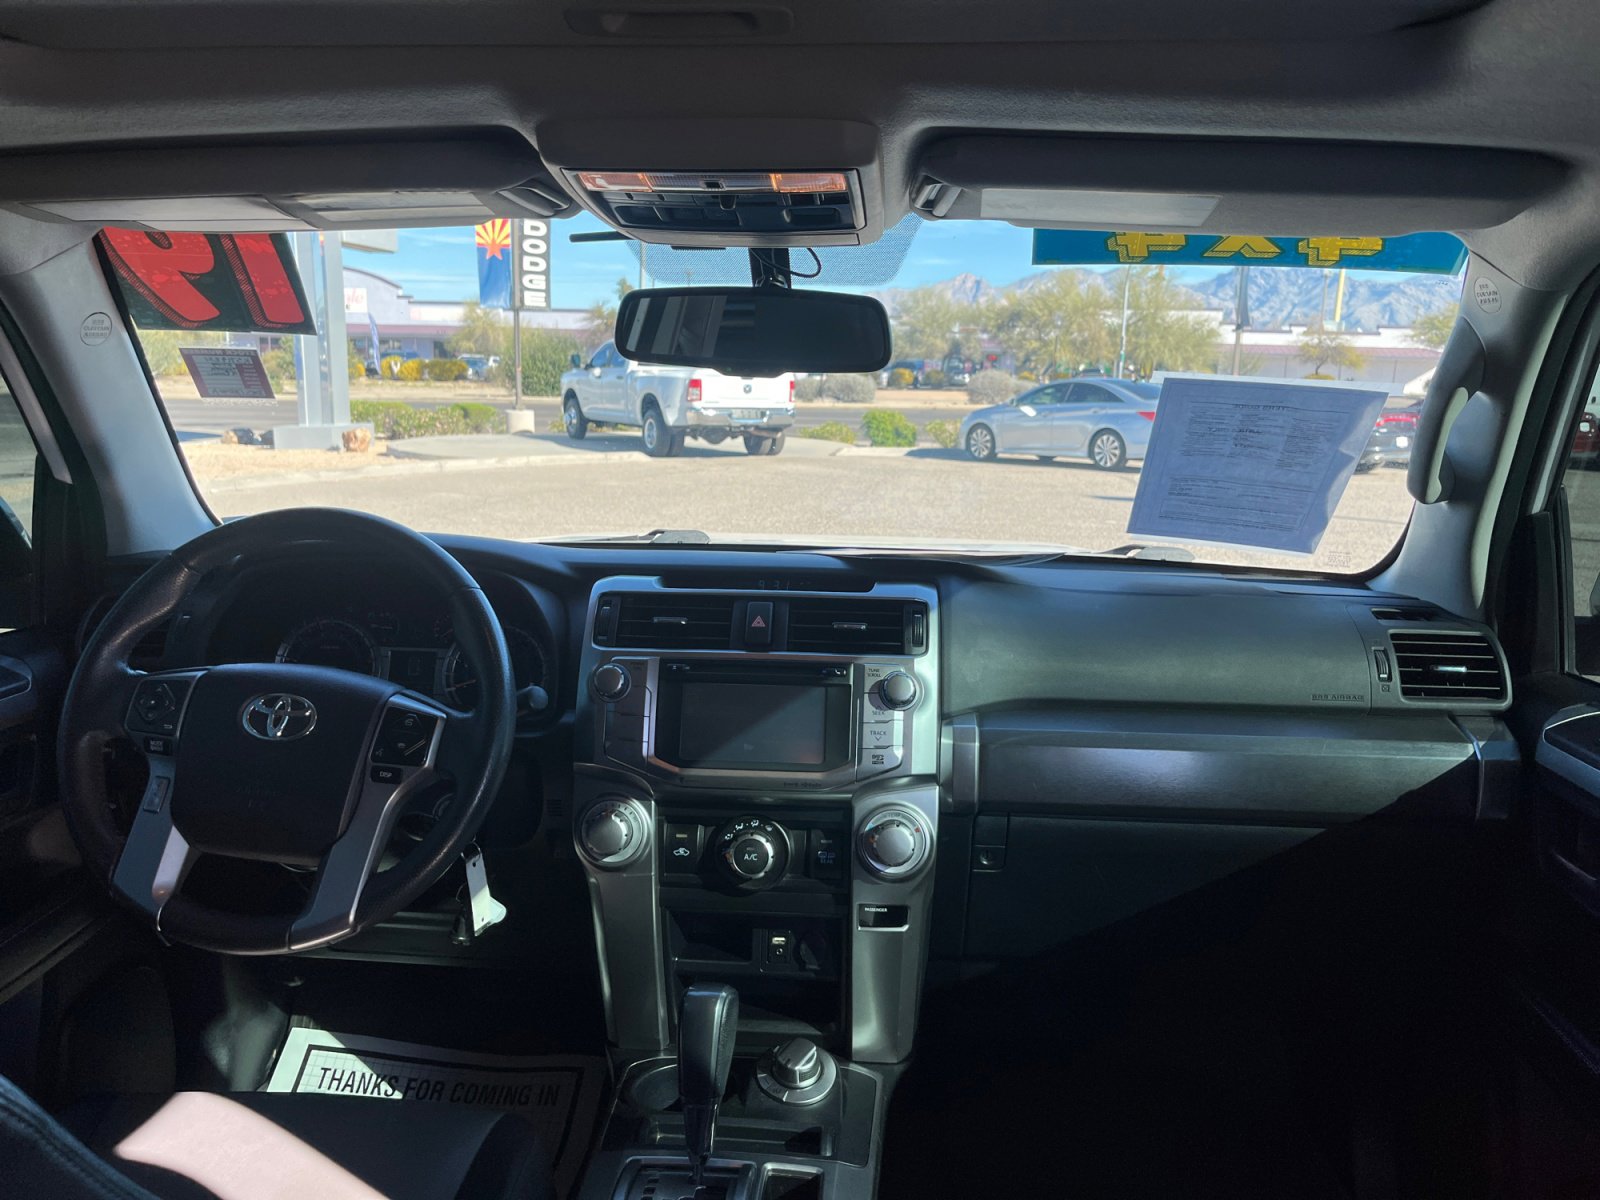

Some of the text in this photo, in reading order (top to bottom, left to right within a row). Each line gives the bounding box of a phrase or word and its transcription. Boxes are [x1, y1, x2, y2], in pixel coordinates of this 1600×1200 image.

[522, 218, 547, 307] DODGE
[743, 853, 758, 861] A/C
[317, 1066, 561, 1107] THANKS FOR COMING IN
